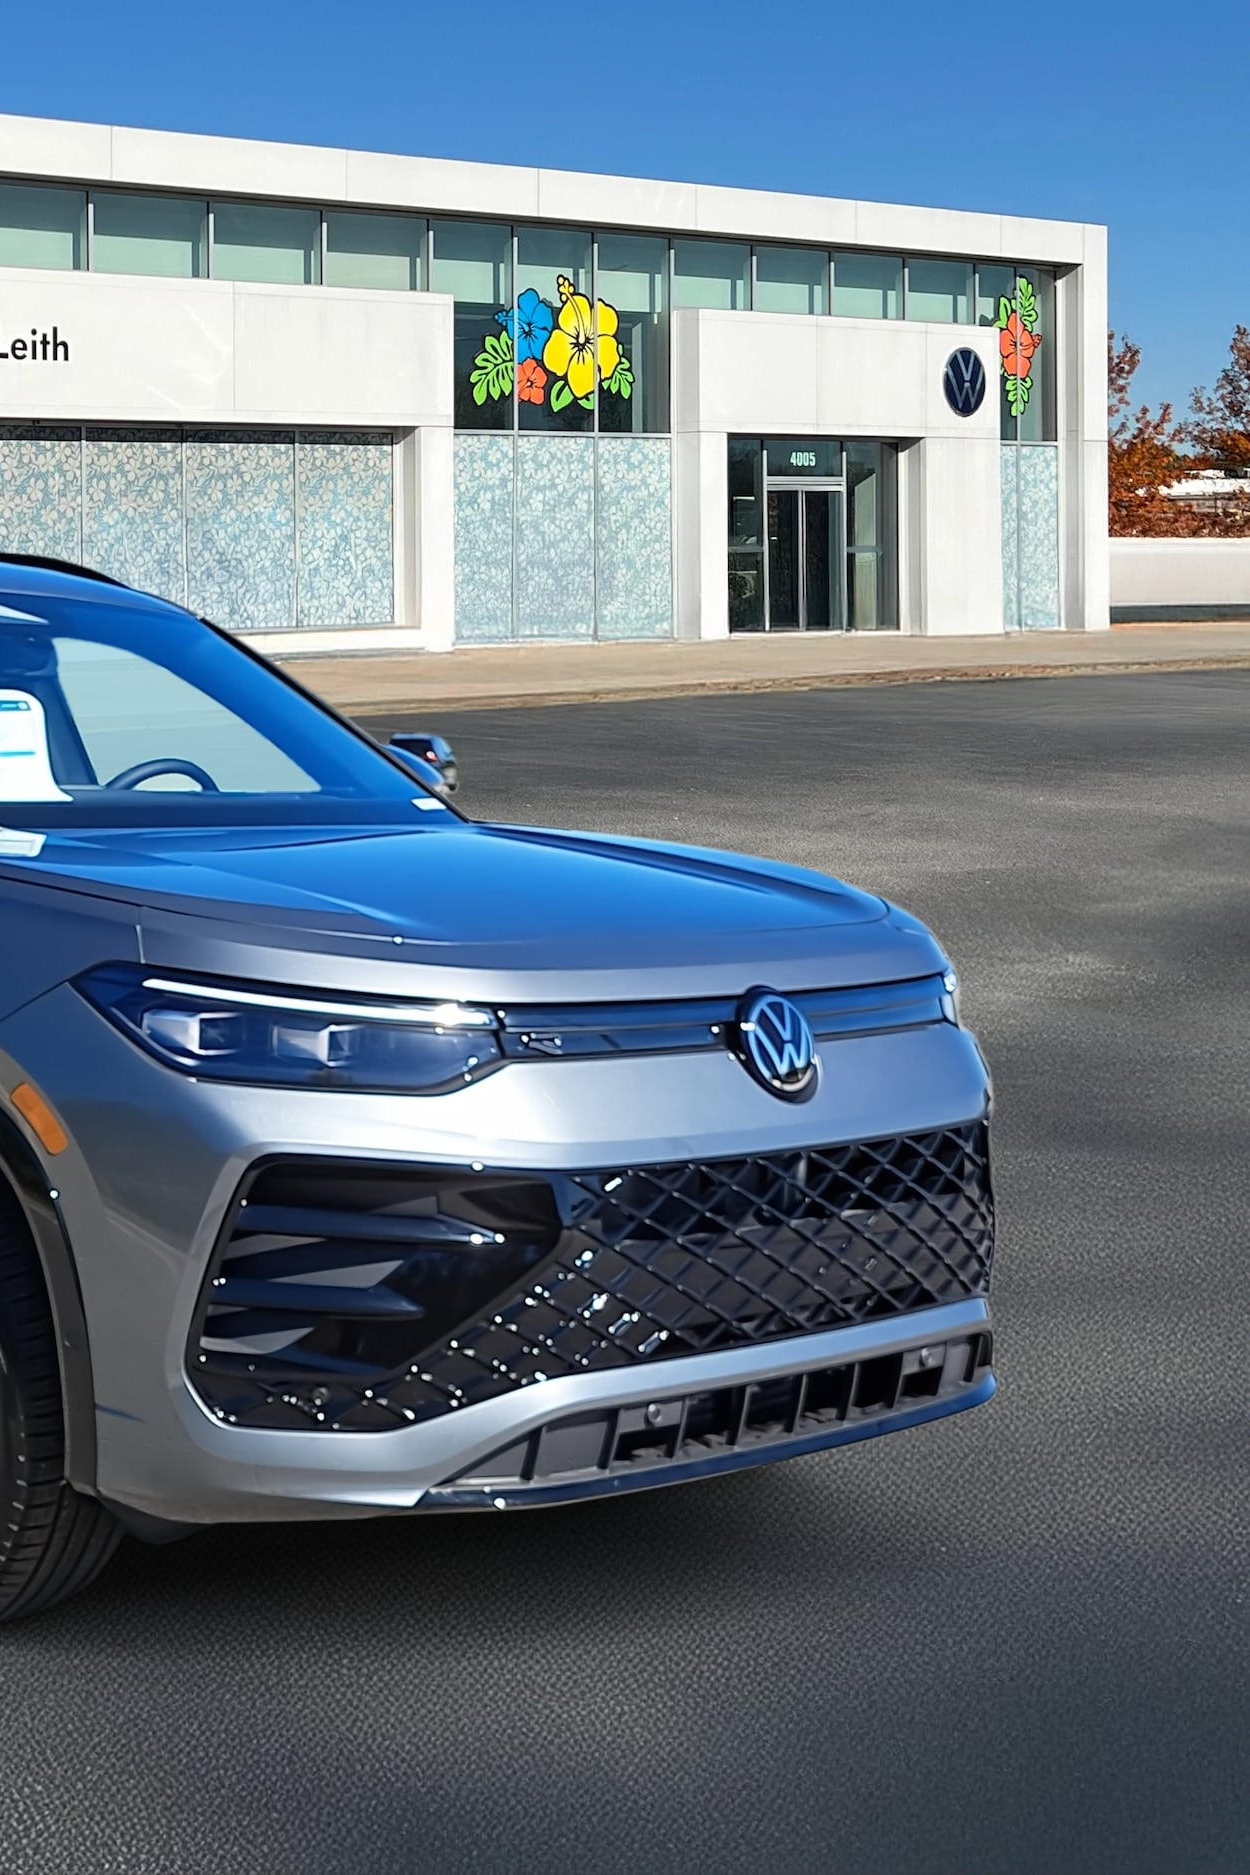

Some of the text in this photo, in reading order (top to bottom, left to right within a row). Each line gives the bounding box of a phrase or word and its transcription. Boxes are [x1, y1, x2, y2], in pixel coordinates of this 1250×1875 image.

[946, 348, 985, 410] VW
[790, 451, 816, 466] 4005
[750, 996, 813, 1078] VW
